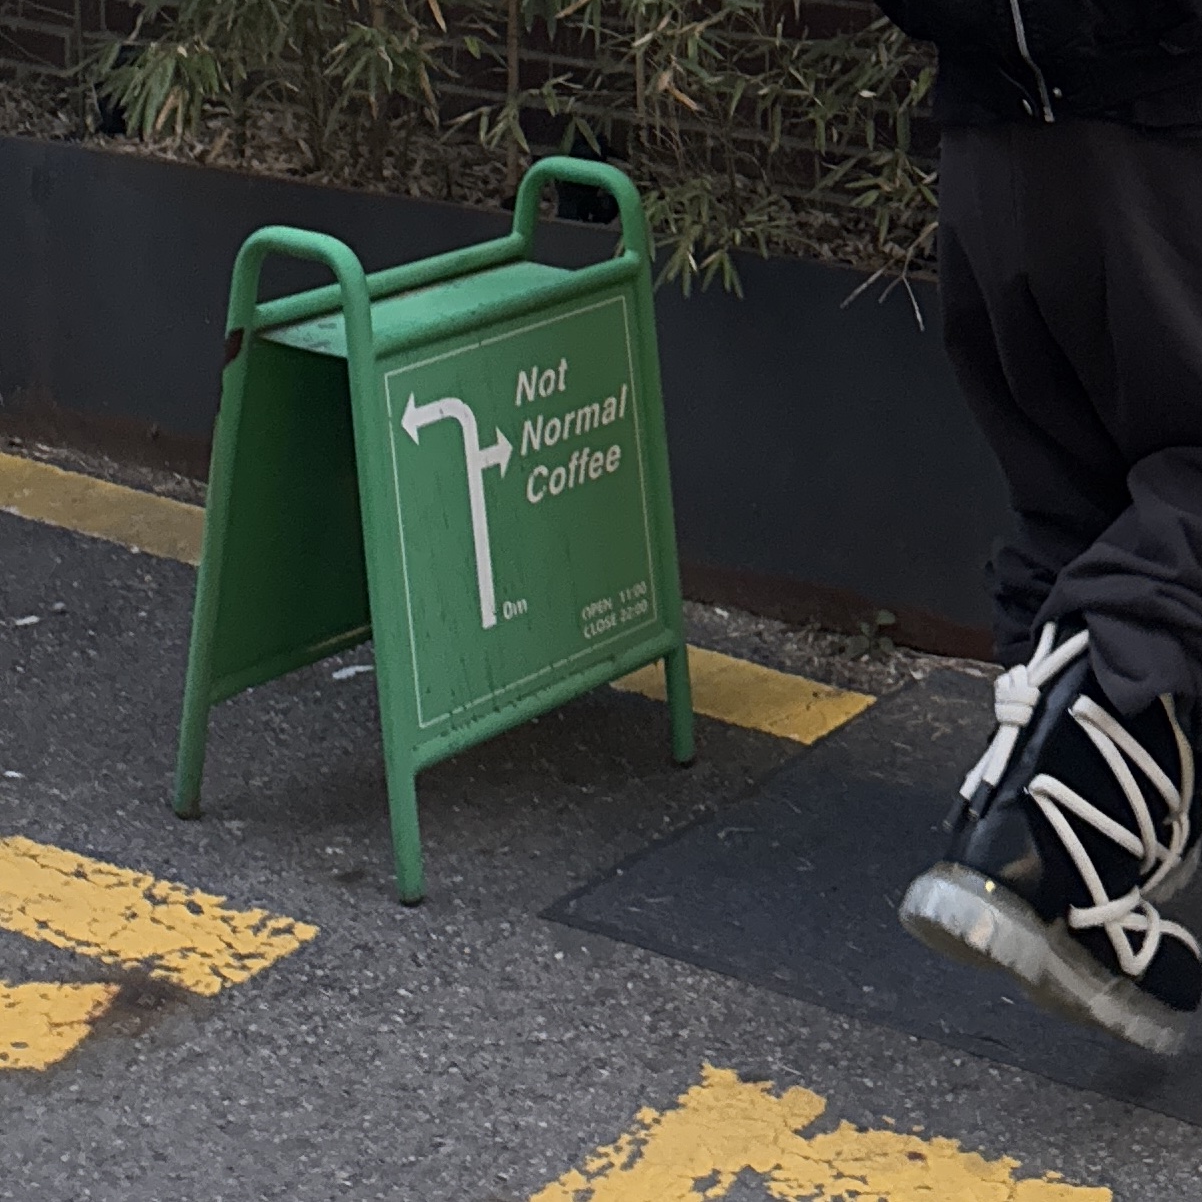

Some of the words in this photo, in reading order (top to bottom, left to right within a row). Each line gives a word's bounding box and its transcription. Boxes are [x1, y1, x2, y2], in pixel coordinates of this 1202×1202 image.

[514, 356, 569, 407] Not
[520, 382, 628, 457] Normal
[526, 444, 622, 504] Coffee
[502, 598, 528, 620] 0m
[581, 596, 613, 621] OPEN
[583, 612, 617, 640] CLOSE
